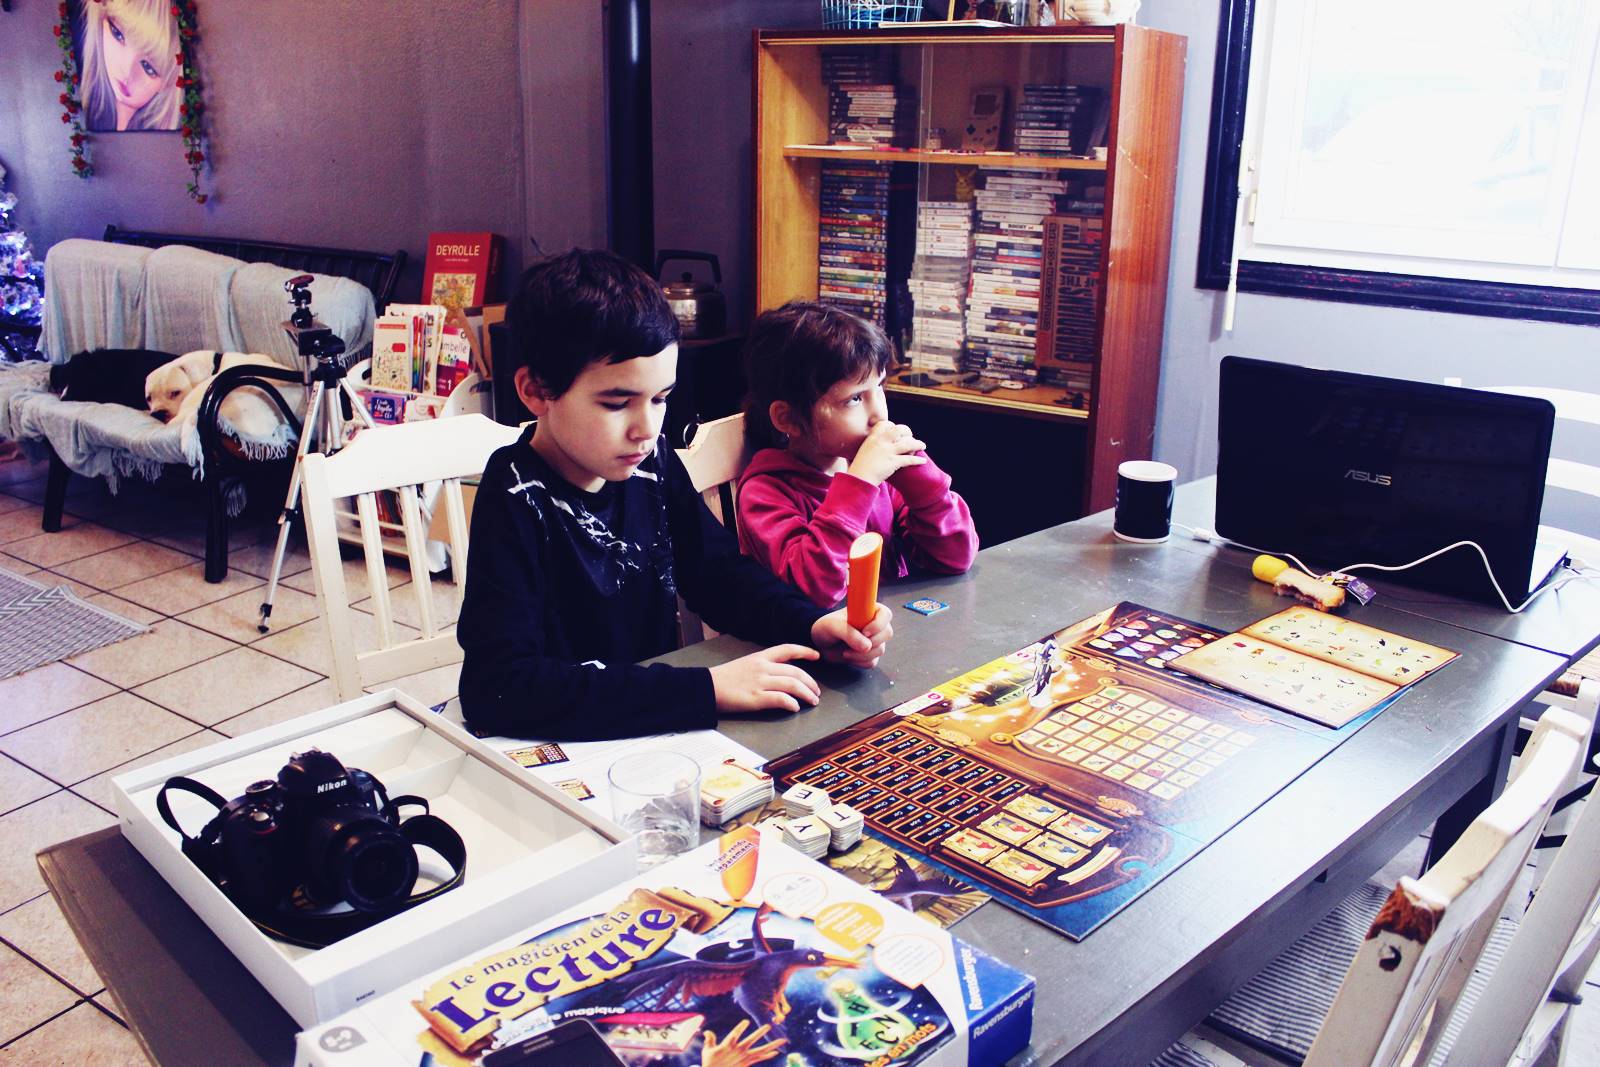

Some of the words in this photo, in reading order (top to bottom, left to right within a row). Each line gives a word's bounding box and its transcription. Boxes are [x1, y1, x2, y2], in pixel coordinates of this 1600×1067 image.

[436, 244, 480, 256] DEYROLLE
[1344, 469, 1392, 486] ASUS
[317, 779, 348, 793] Nikon
[832, 811, 851, 821] T
[449, 973, 477, 991] Le
[482, 934, 588, 976] magicien
[590, 919, 614, 941] de
[613, 909, 630, 926] la
[430, 907, 676, 1034] Lecture
[564, 1006, 626, 1018] magique
[973, 990, 1033, 1040] Ravensburger
[907, 1022, 938, 1046] mots
